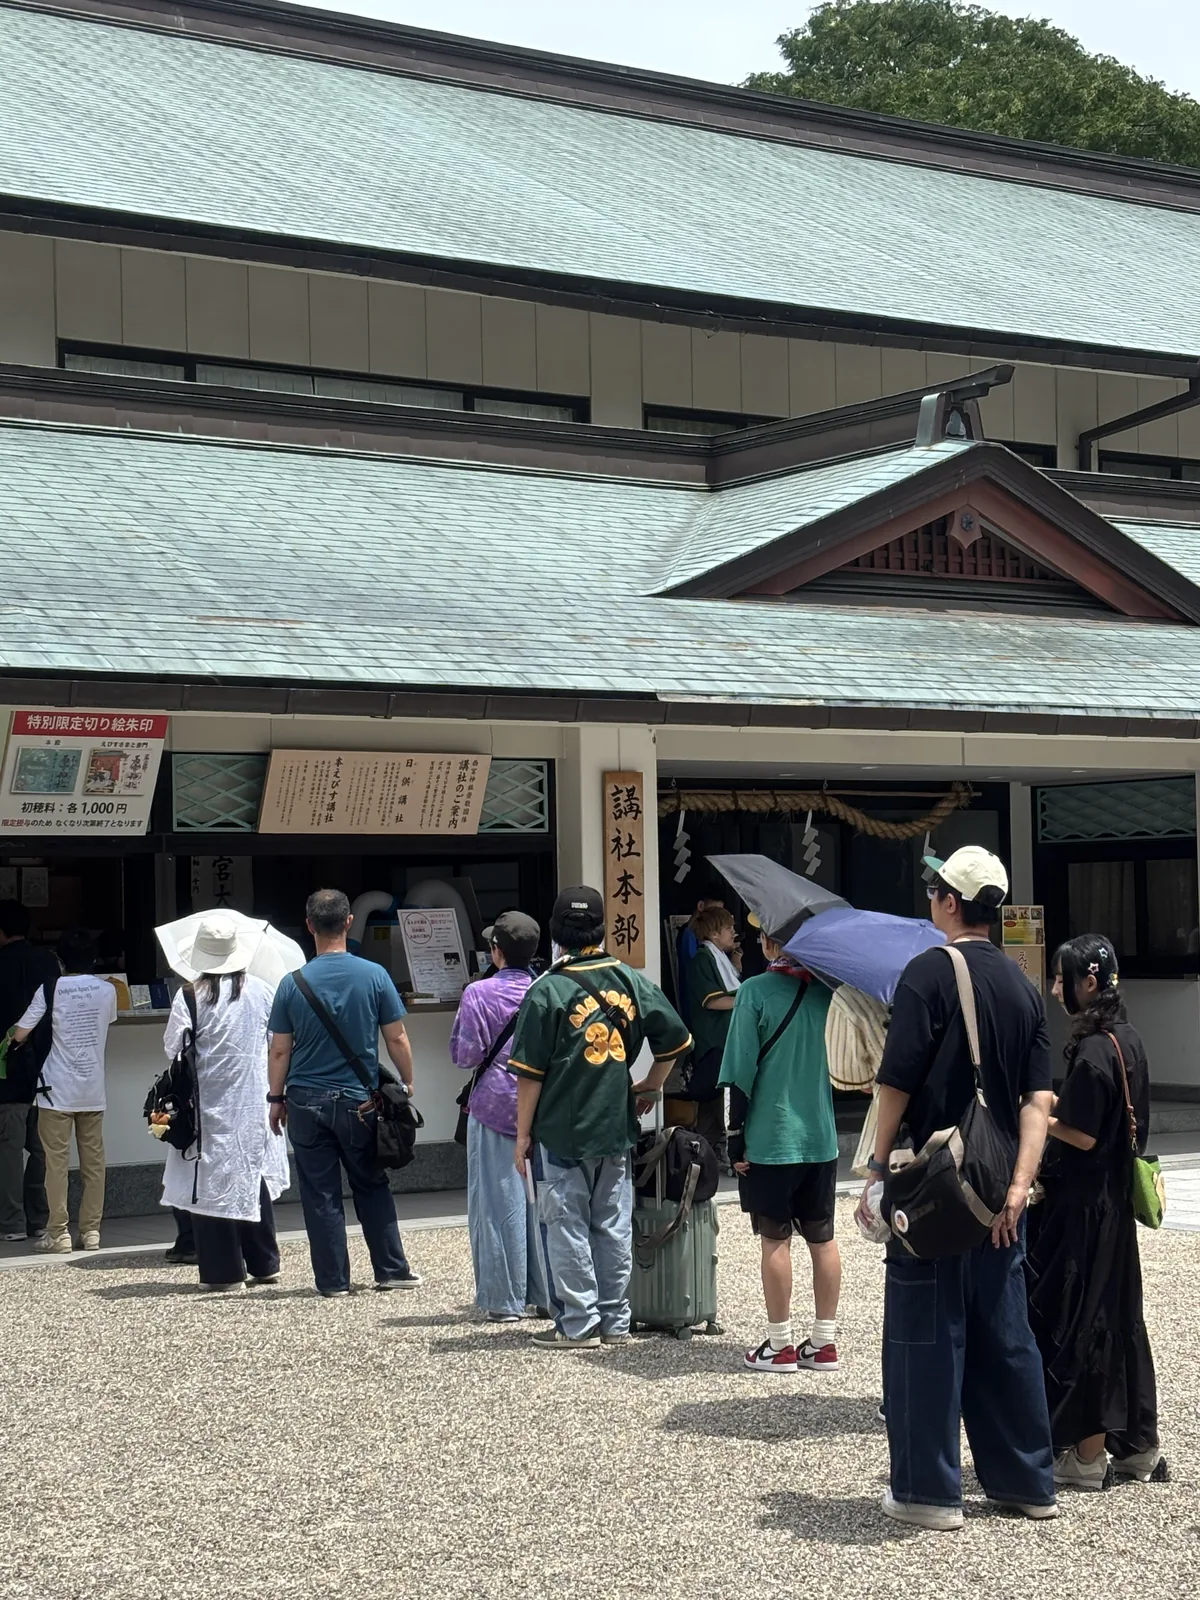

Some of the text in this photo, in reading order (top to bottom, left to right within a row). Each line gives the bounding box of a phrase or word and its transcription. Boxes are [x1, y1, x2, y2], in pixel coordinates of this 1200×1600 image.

[26, 714, 154, 733] 特別限定切り絵朱印
[324, 756, 343, 823] 本えびす講社
[395, 758, 414, 824] 日供講社
[448, 759, 470, 829] 講社のご案内
[610, 784, 643, 957] 講社本部
